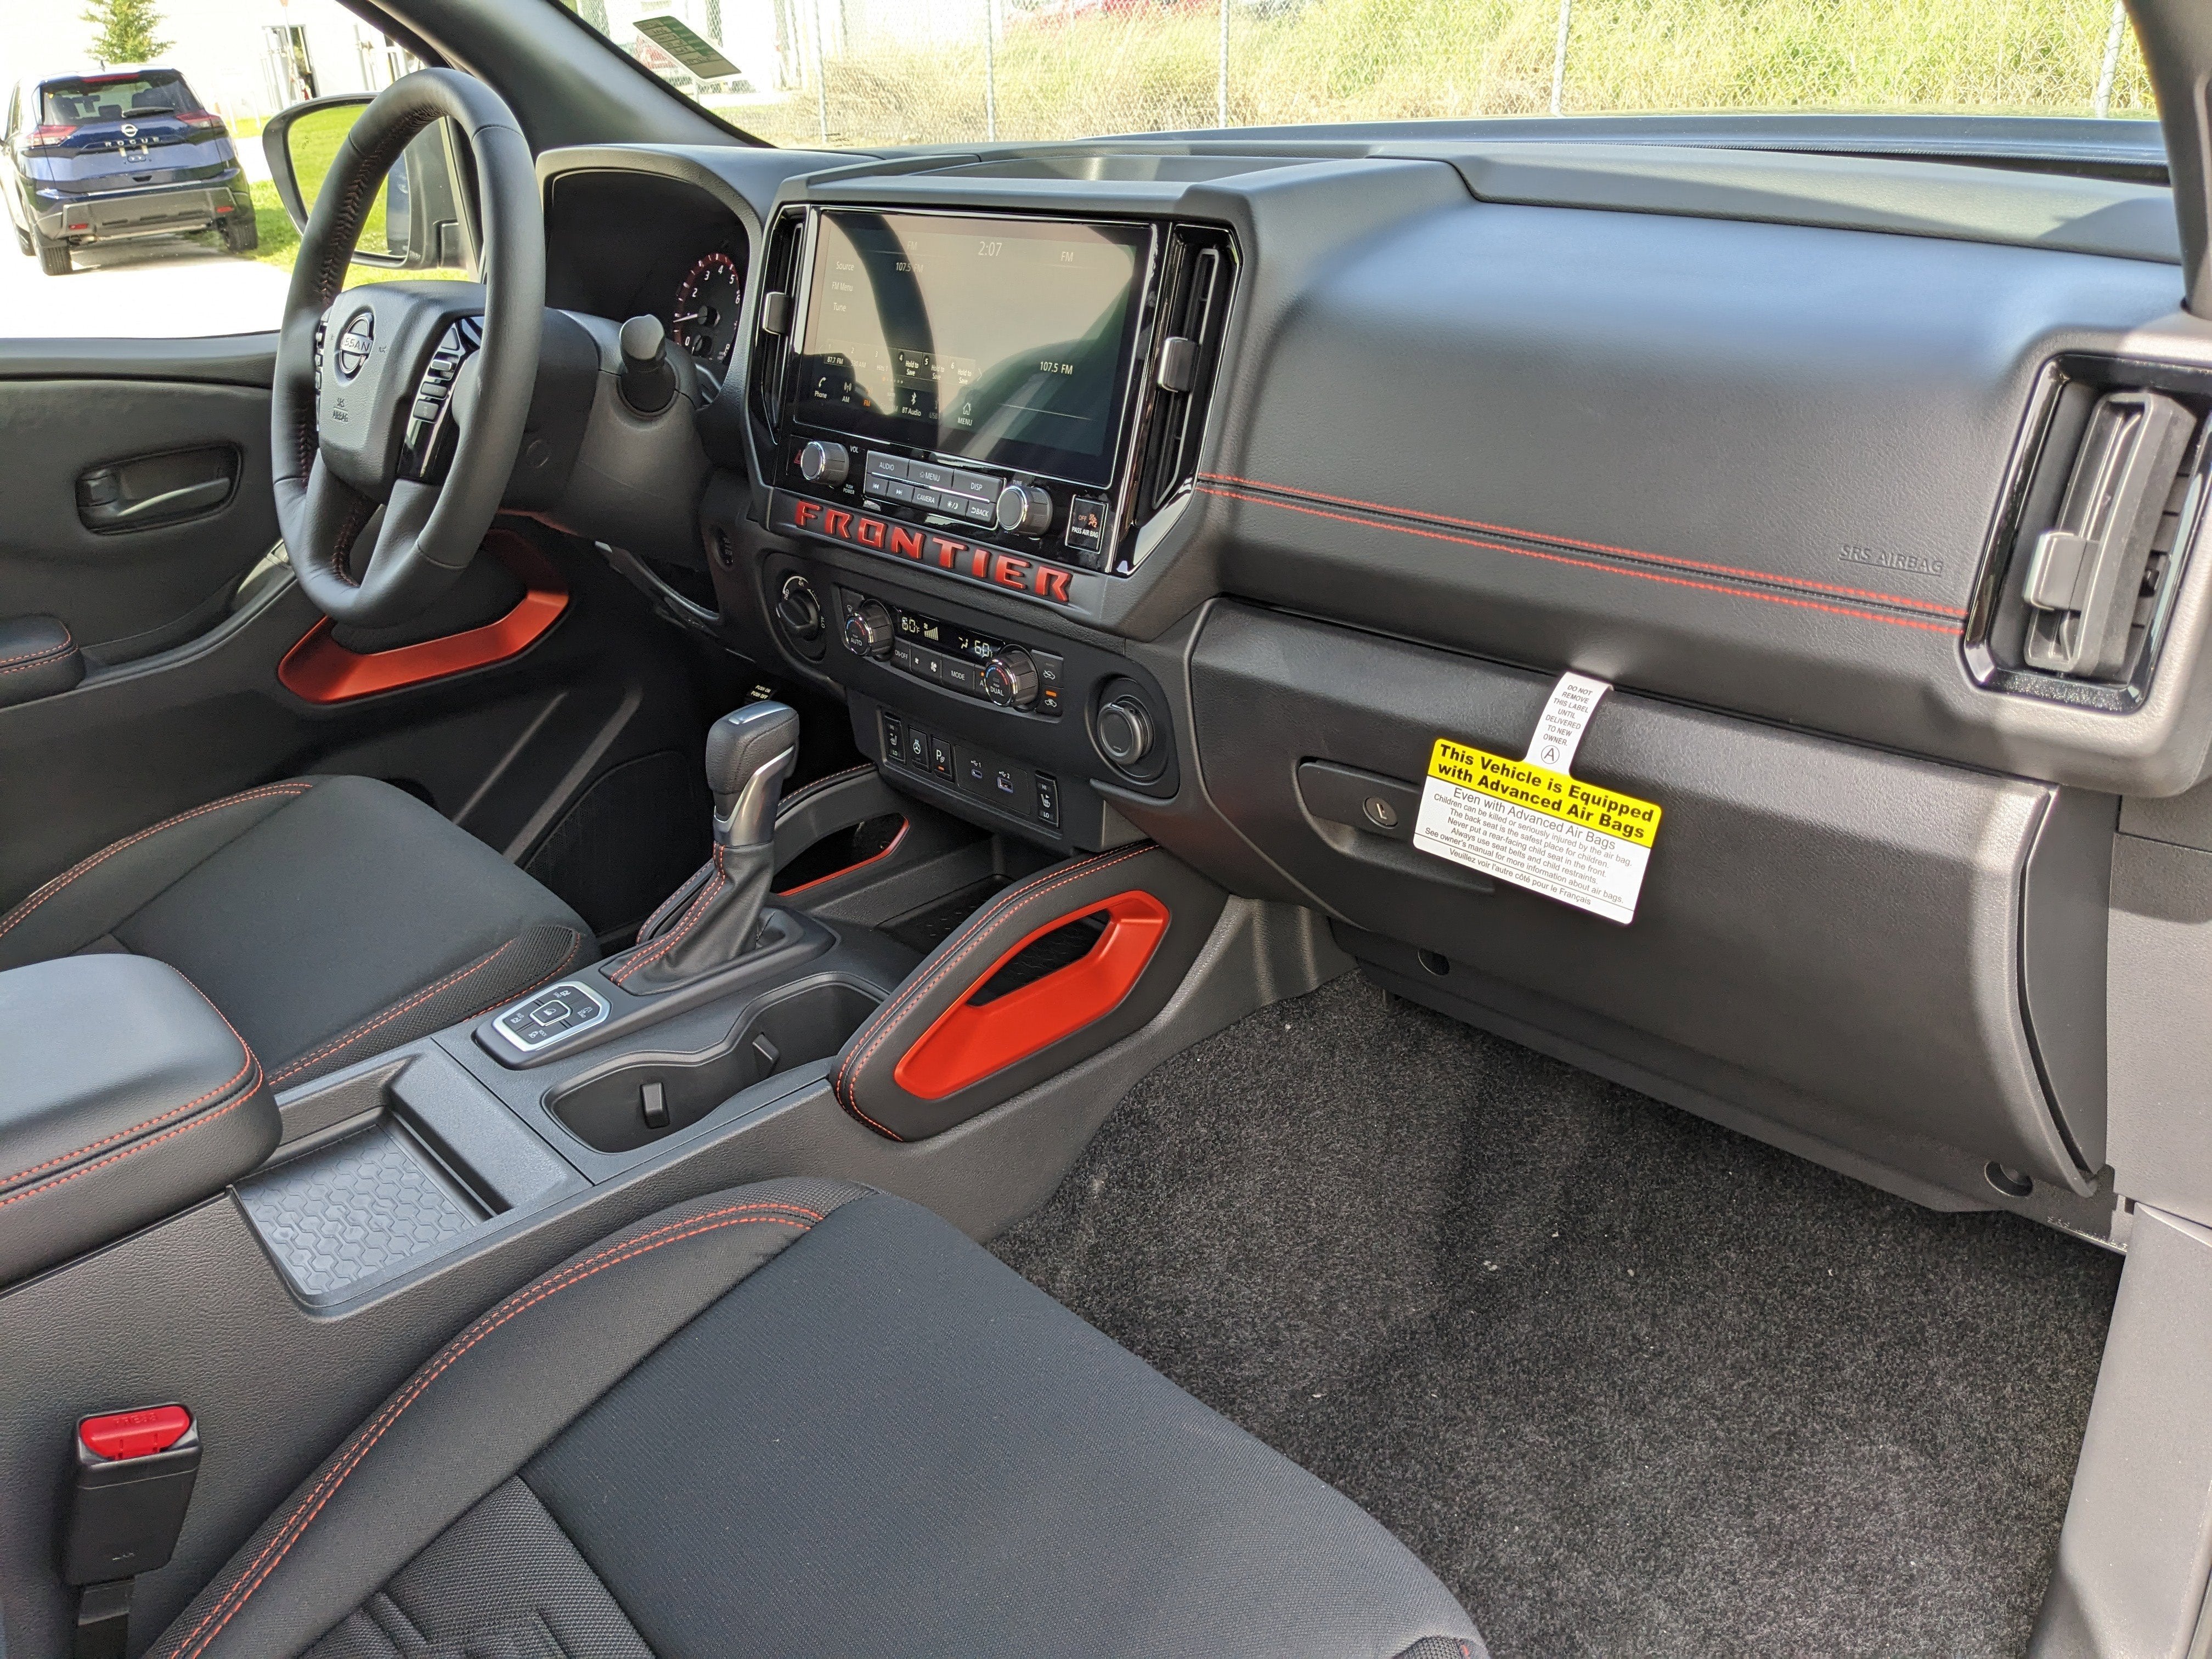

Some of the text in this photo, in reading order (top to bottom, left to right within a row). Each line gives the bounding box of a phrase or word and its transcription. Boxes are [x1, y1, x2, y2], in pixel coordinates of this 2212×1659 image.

[907, 241, 917, 250] FM
[978, 241, 1002, 256] 2:07
[1061, 251, 1073, 262] FM
[718, 265, 724, 274] 4
[836, 261, 855, 271] Source
[896, 262, 923, 273] 107.5 FM
[704, 270, 710, 280] 3
[729, 274, 735, 284] 5
[832, 281, 853, 291] FM Menu
[692, 287, 697, 297] 2
[735, 294, 741, 304] 6
[833, 302, 847, 312] Tune
[905, 360, 915, 368] Hold
[932, 364, 940, 373] Hold
[1040, 361, 1073, 375] 107.5 FM
[815, 390, 827, 399] Phone
[908, 408, 921, 416] Audio
[957, 417, 973, 426] MENU
[879, 462, 894, 471] AUDIO
[925, 473, 940, 482] MENU
[970, 482, 983, 490] DISP
[917, 494, 935, 504] CAMERA
[975, 508, 989, 517] BACK
[1090, 529, 1099, 538] BAG
[795, 500, 1073, 602] FRONTIER
[1839, 545, 1944, 574] SRS AIRBAG
[850, 637, 862, 646] AUTO
[951, 670, 966, 680] MODE
[990, 686, 1005, 697] DUAL
[1578, 687, 1593, 696] NOT
[1562, 691, 1590, 704] REMOVE
[1554, 698, 1588, 713] THIS LABEL
[1558, 708, 1576, 719] UNTIL
[1545, 714, 1581, 730] DELIVERED
[1547, 724, 1572, 737] TO NEW
[1543, 733, 1567, 746] OWNER.
[1440, 743, 1654, 822] This Vehicle is Equipped
[1438, 763, 1644, 838] with Advanced Air Bags
[1453, 787, 1615, 850] Even with Advanced Air Bags
[1434, 793, 1462, 808] Children
[1463, 804, 1476, 813] can
[1477, 807, 1487, 817] be
[1488, 811, 1507, 823] killed
[1517, 823, 1550, 839] seriously
[1551, 832, 1577, 847] injured
[1578, 842, 1588, 852] by
[1589, 845, 1601, 855] the
[1615, 854, 1632, 866] bag.
[1450, 807, 1609, 868] The back seat is the safest place for children.
[1447, 816, 1469, 829] Never
[1469, 825, 1481, 834] put
[1488, 832, 1527, 851] rear-facing
[1528, 845, 1546, 856] child
[1547, 853, 1563, 862] seat
[1564, 857, 1571, 865] in
[1573, 860, 1585, 870] the
[1587, 865, 1606, 877] front.
[1450, 827, 1598, 884] Always use seat belts and child restraints.
[1425, 827, 1438, 837] See
[1440, 834, 1466, 847] owner's
[1468, 843, 1494, 857] manual
[1495, 851, 1505, 860] for
[1506, 857, 1525, 868] more
[1526, 862, 1566, 883] information
[1568, 879, 1589, 891] about
[1602, 890, 1623, 903] bags.
[1449, 847, 1590, 905] Veuillez voir l'autre côté pour le Français
